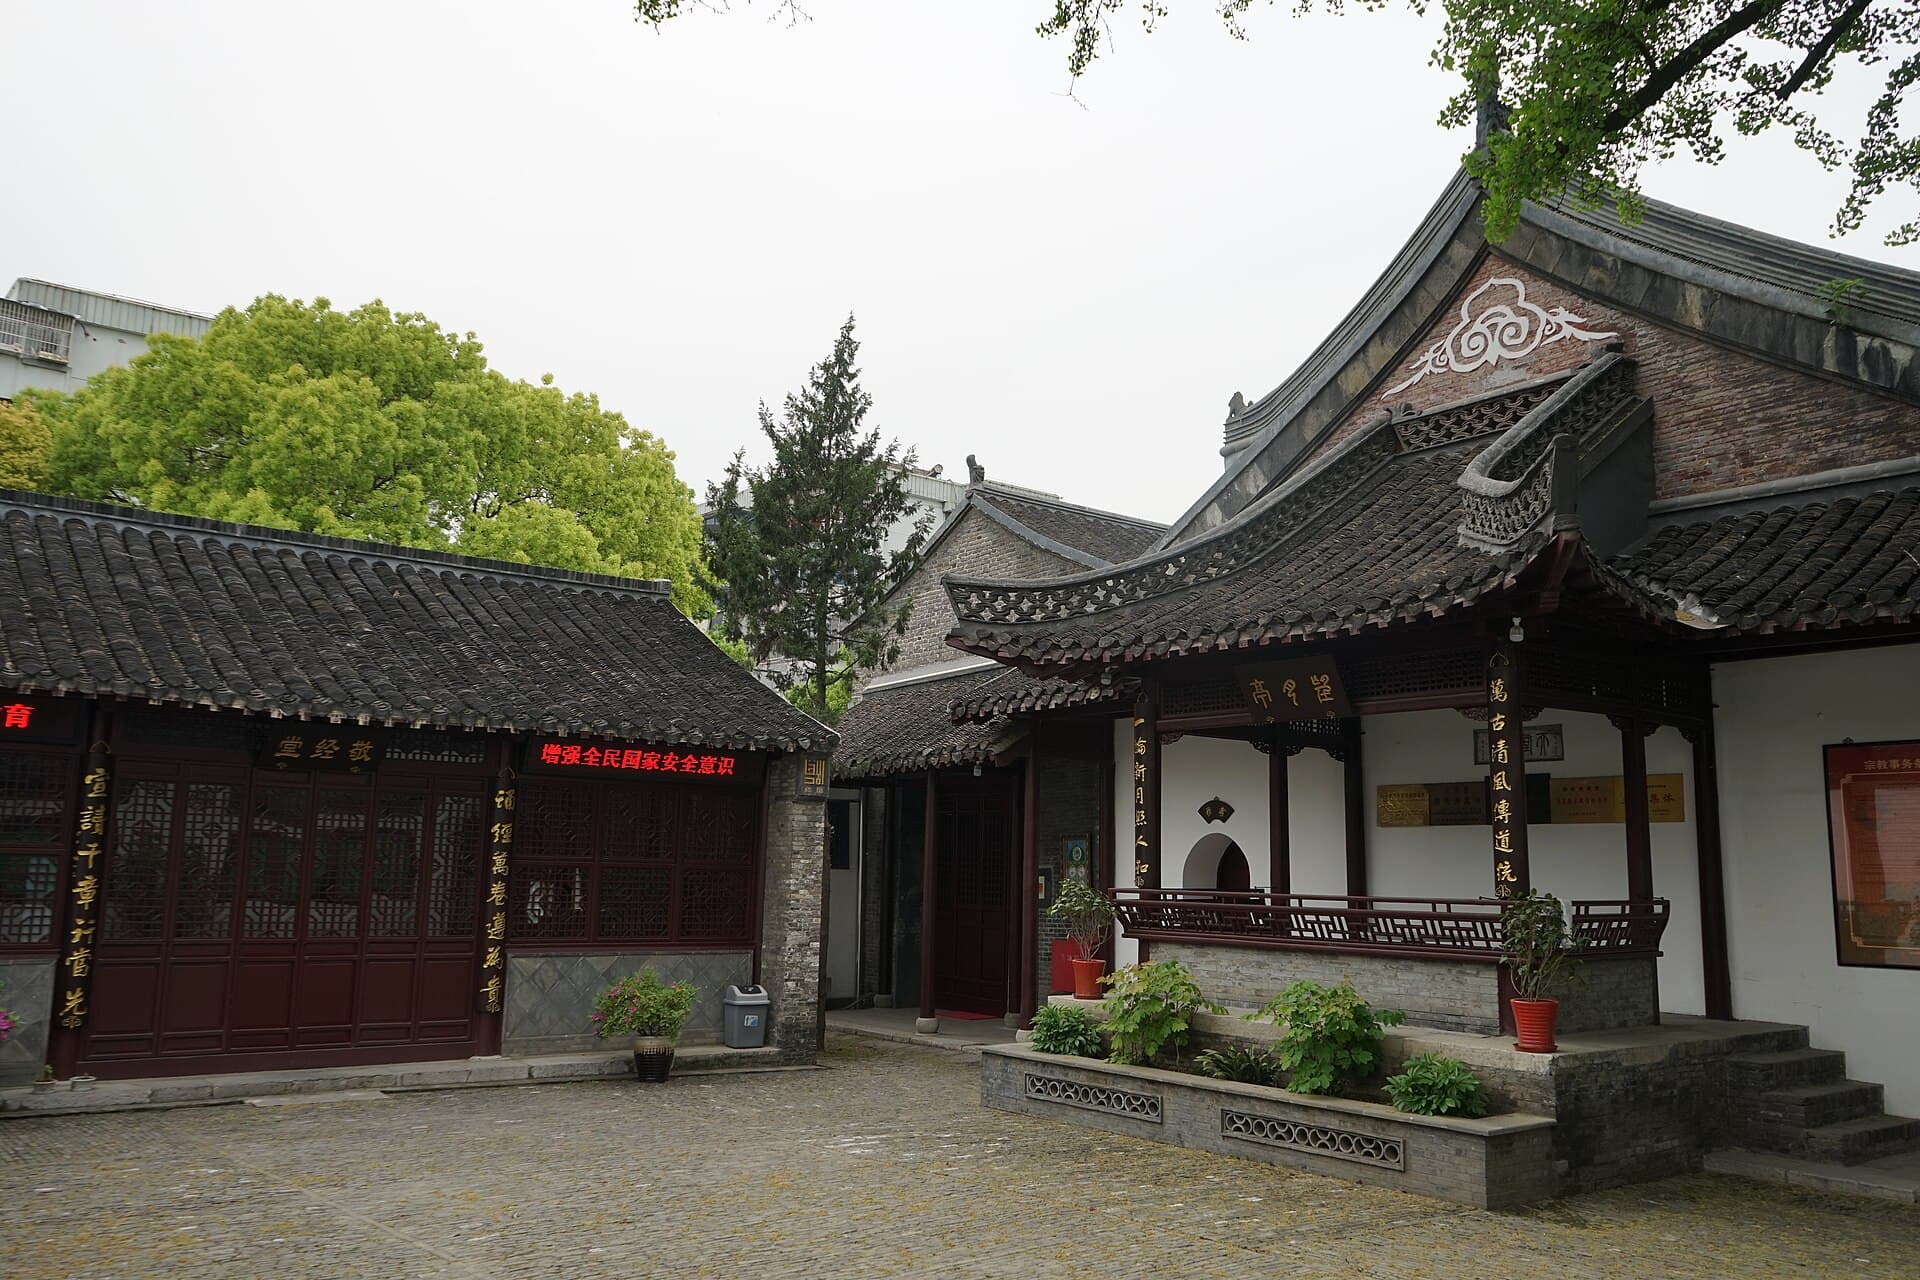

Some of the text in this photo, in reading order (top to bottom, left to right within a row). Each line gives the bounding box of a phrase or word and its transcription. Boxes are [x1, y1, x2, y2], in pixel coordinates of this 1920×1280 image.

[0, 703, 37, 729] 育
[541, 743, 736, 775] 增强全民国家安全意识
